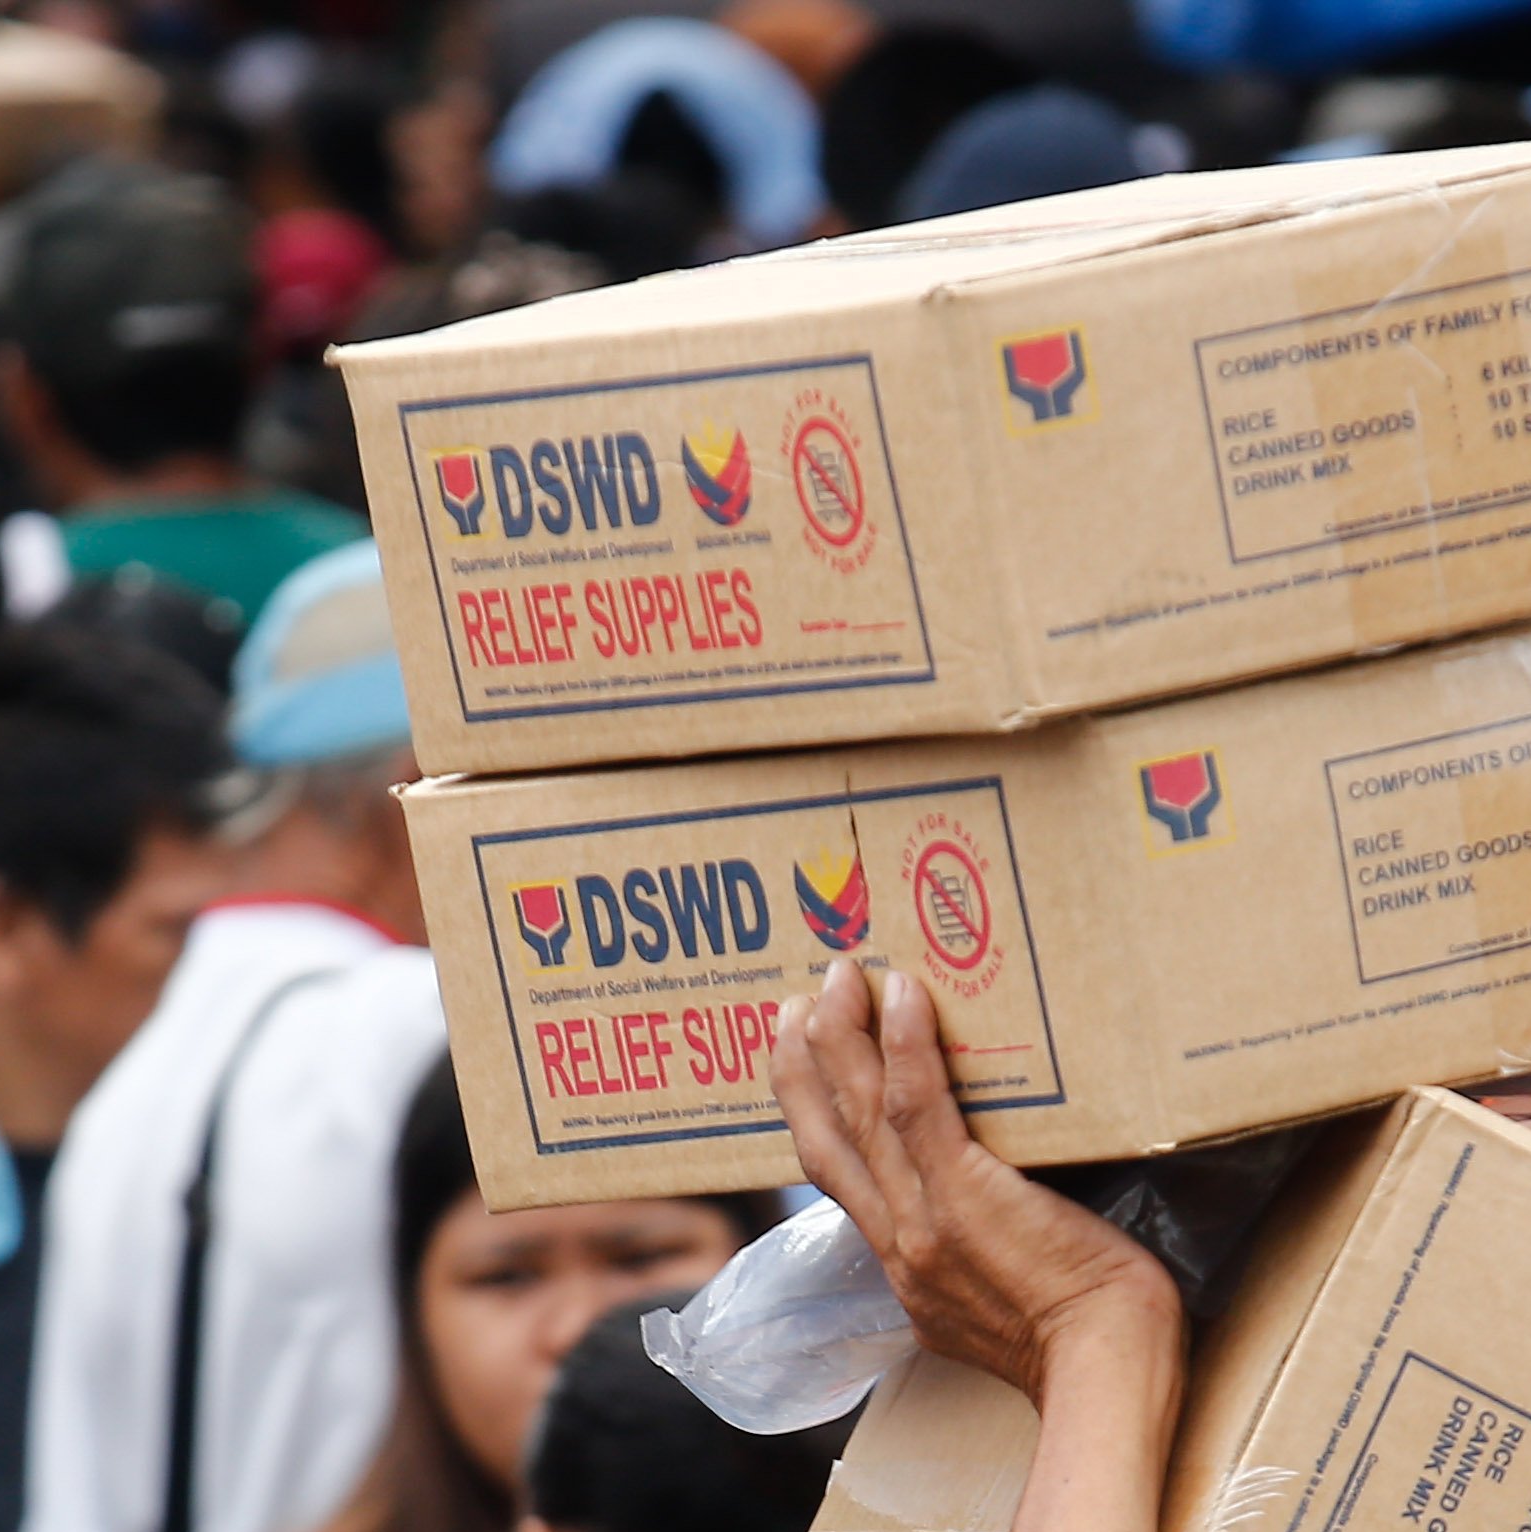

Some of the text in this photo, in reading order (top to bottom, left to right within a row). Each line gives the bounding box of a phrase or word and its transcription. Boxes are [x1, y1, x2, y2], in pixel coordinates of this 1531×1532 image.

[1217, 328, 1380, 379] COMPONENTS
[1386, 319, 1416, 343] OF
[1423, 302, 1502, 335] FAMILY
[1222, 408, 1276, 437] RICE
[1480, 363, 1494, 382] 6
[1227, 428, 1325, 467] CANNED
[1331, 409, 1415, 444] GOODS
[1487, 388, 1512, 410] 10
[487, 431, 661, 539] DSWD
[1232, 464, 1305, 496] DRINK
[1311, 456, 1352, 479] MIX
[1492, 417, 1517, 440] 10
[457, 567, 763, 668] RELIEF SUPPLIES
[1347, 749, 1502, 801] COMPONENTS
[900, 811, 989, 880] NOT FOR SALE
[1352, 828, 1404, 857] RICE
[1357, 849, 1450, 887] CANNED
[575, 858, 771, 968] DSWD
[1362, 883, 1431, 917] DRINK
[1436, 873, 1476, 899] MIX
[528, 963, 784, 1006] Department of Social Welfare and Development
[923, 949, 949, 983] NOT
[952, 978, 981, 999] FOR
[974, 945, 1002, 989] SALE
[534, 1000, 780, 1098] RELIEF SUPP
[1423, 1395, 1473, 1475] DRINK
[1438, 1410, 1498, 1513] CANNED
[1483, 1422, 1525, 1484] RICE
[1400, 1476, 1435, 1524] MIX
